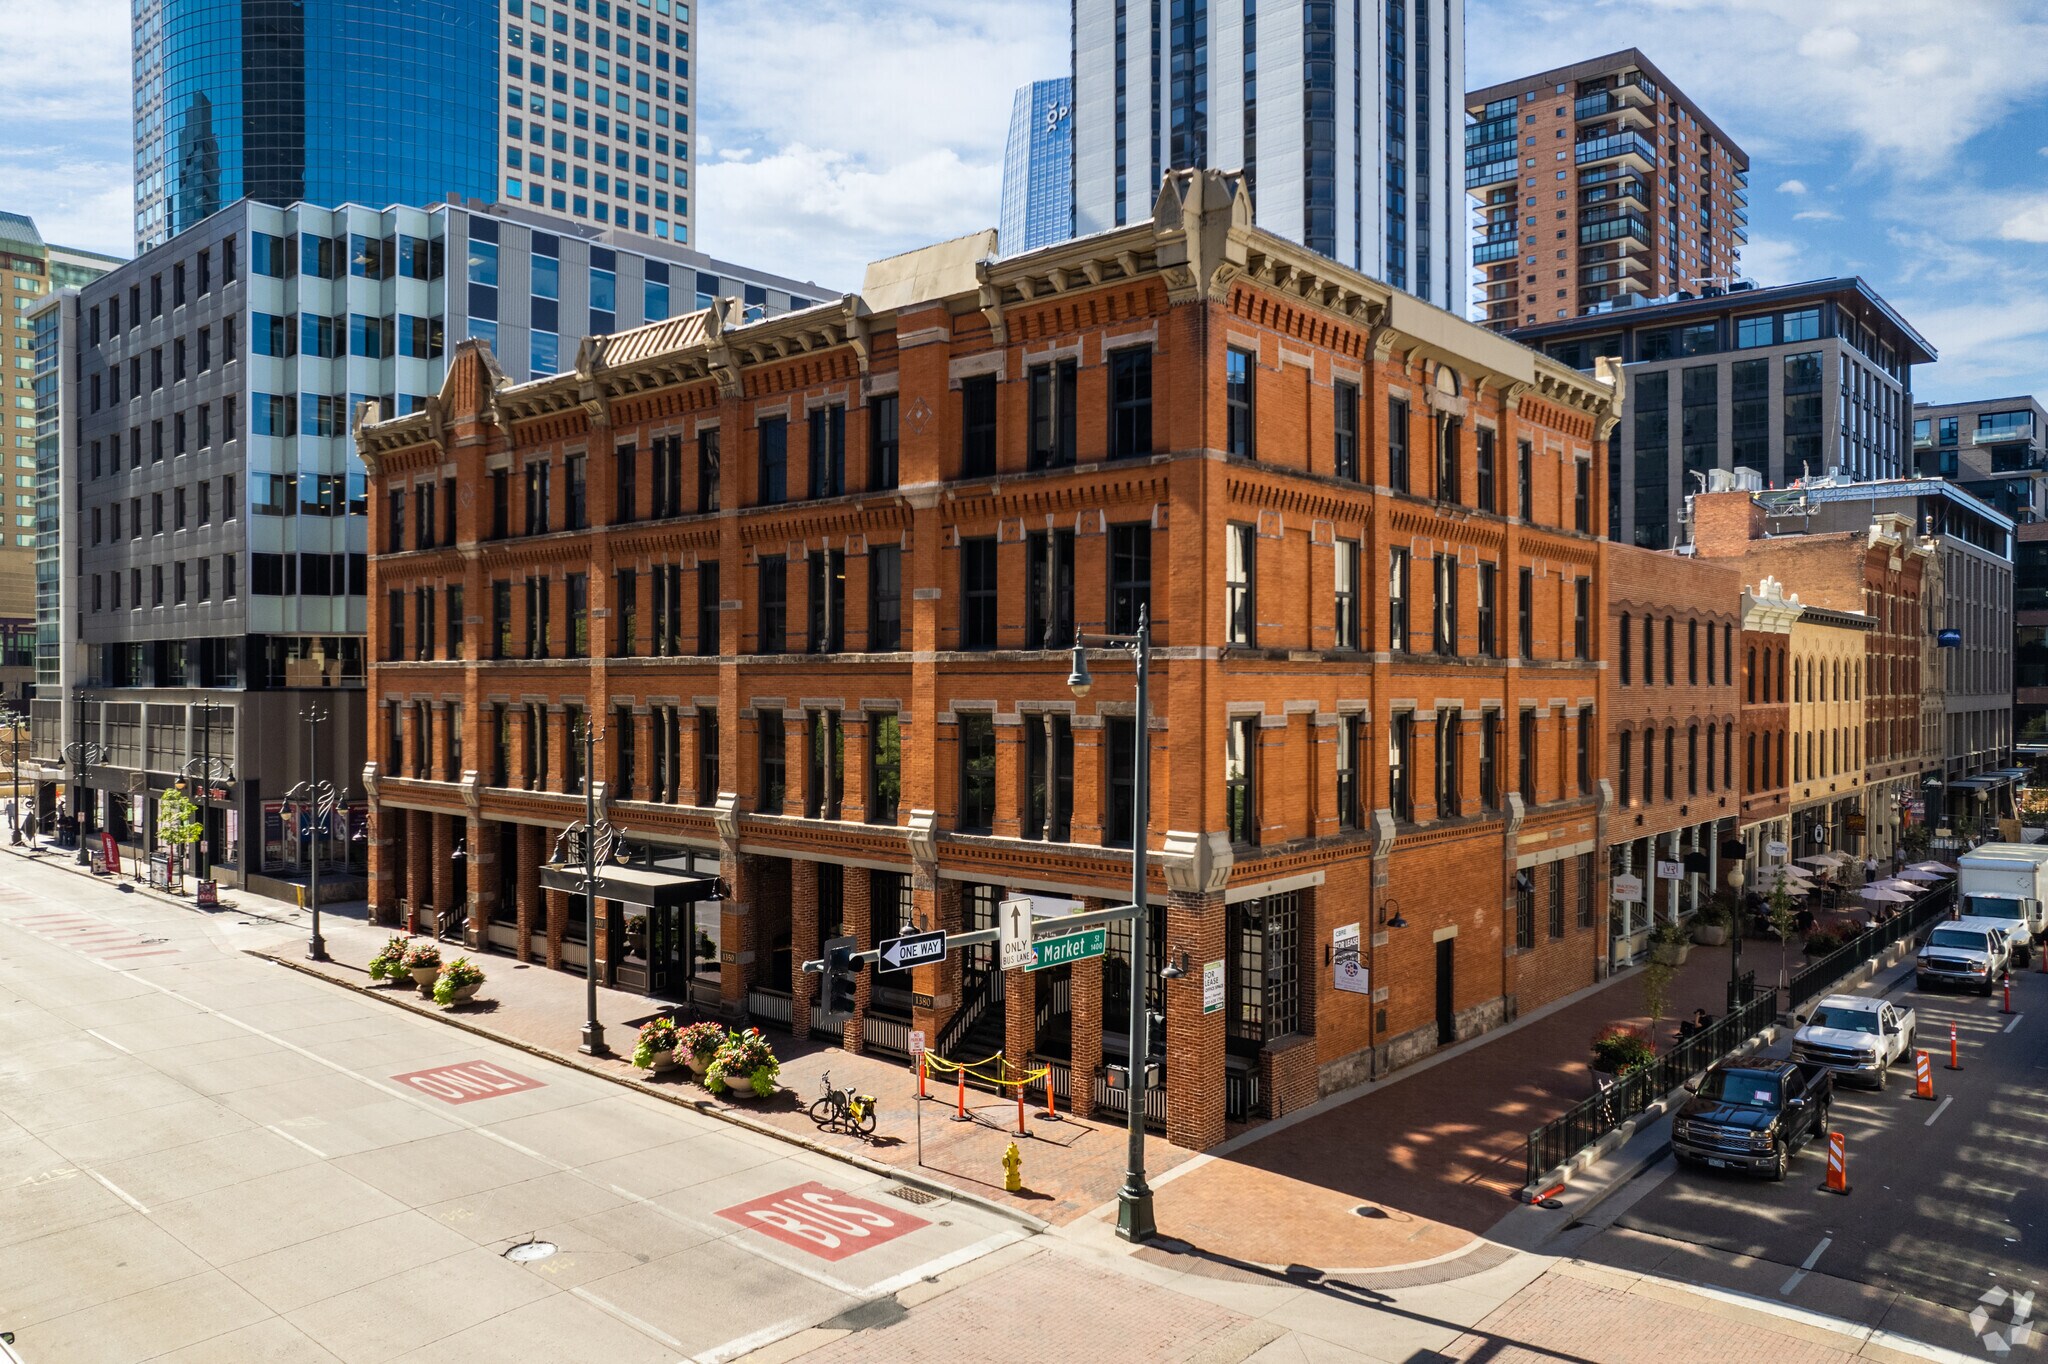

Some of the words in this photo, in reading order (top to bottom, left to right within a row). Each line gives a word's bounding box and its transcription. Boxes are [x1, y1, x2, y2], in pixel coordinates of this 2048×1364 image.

[900, 944, 918, 959] ONE
[921, 940, 939, 954] WAY
[1005, 939, 1028, 954] ONLY
[1044, 938, 1085, 962] Market
[1090, 942, 1103, 951] 1400
[1335, 941, 1345, 950] FOR
[1345, 937, 1359, 948] LEASE
[1003, 955, 1015, 965] BUS
[1016, 952, 1030, 962] LANE
[1204, 970, 1215, 979] FOR
[1204, 976, 1219, 987] LEASE
[915, 996, 931, 1007] 1380
[409, 1063, 527, 1099] ONLY
[744, 1192, 896, 1249] BUS
